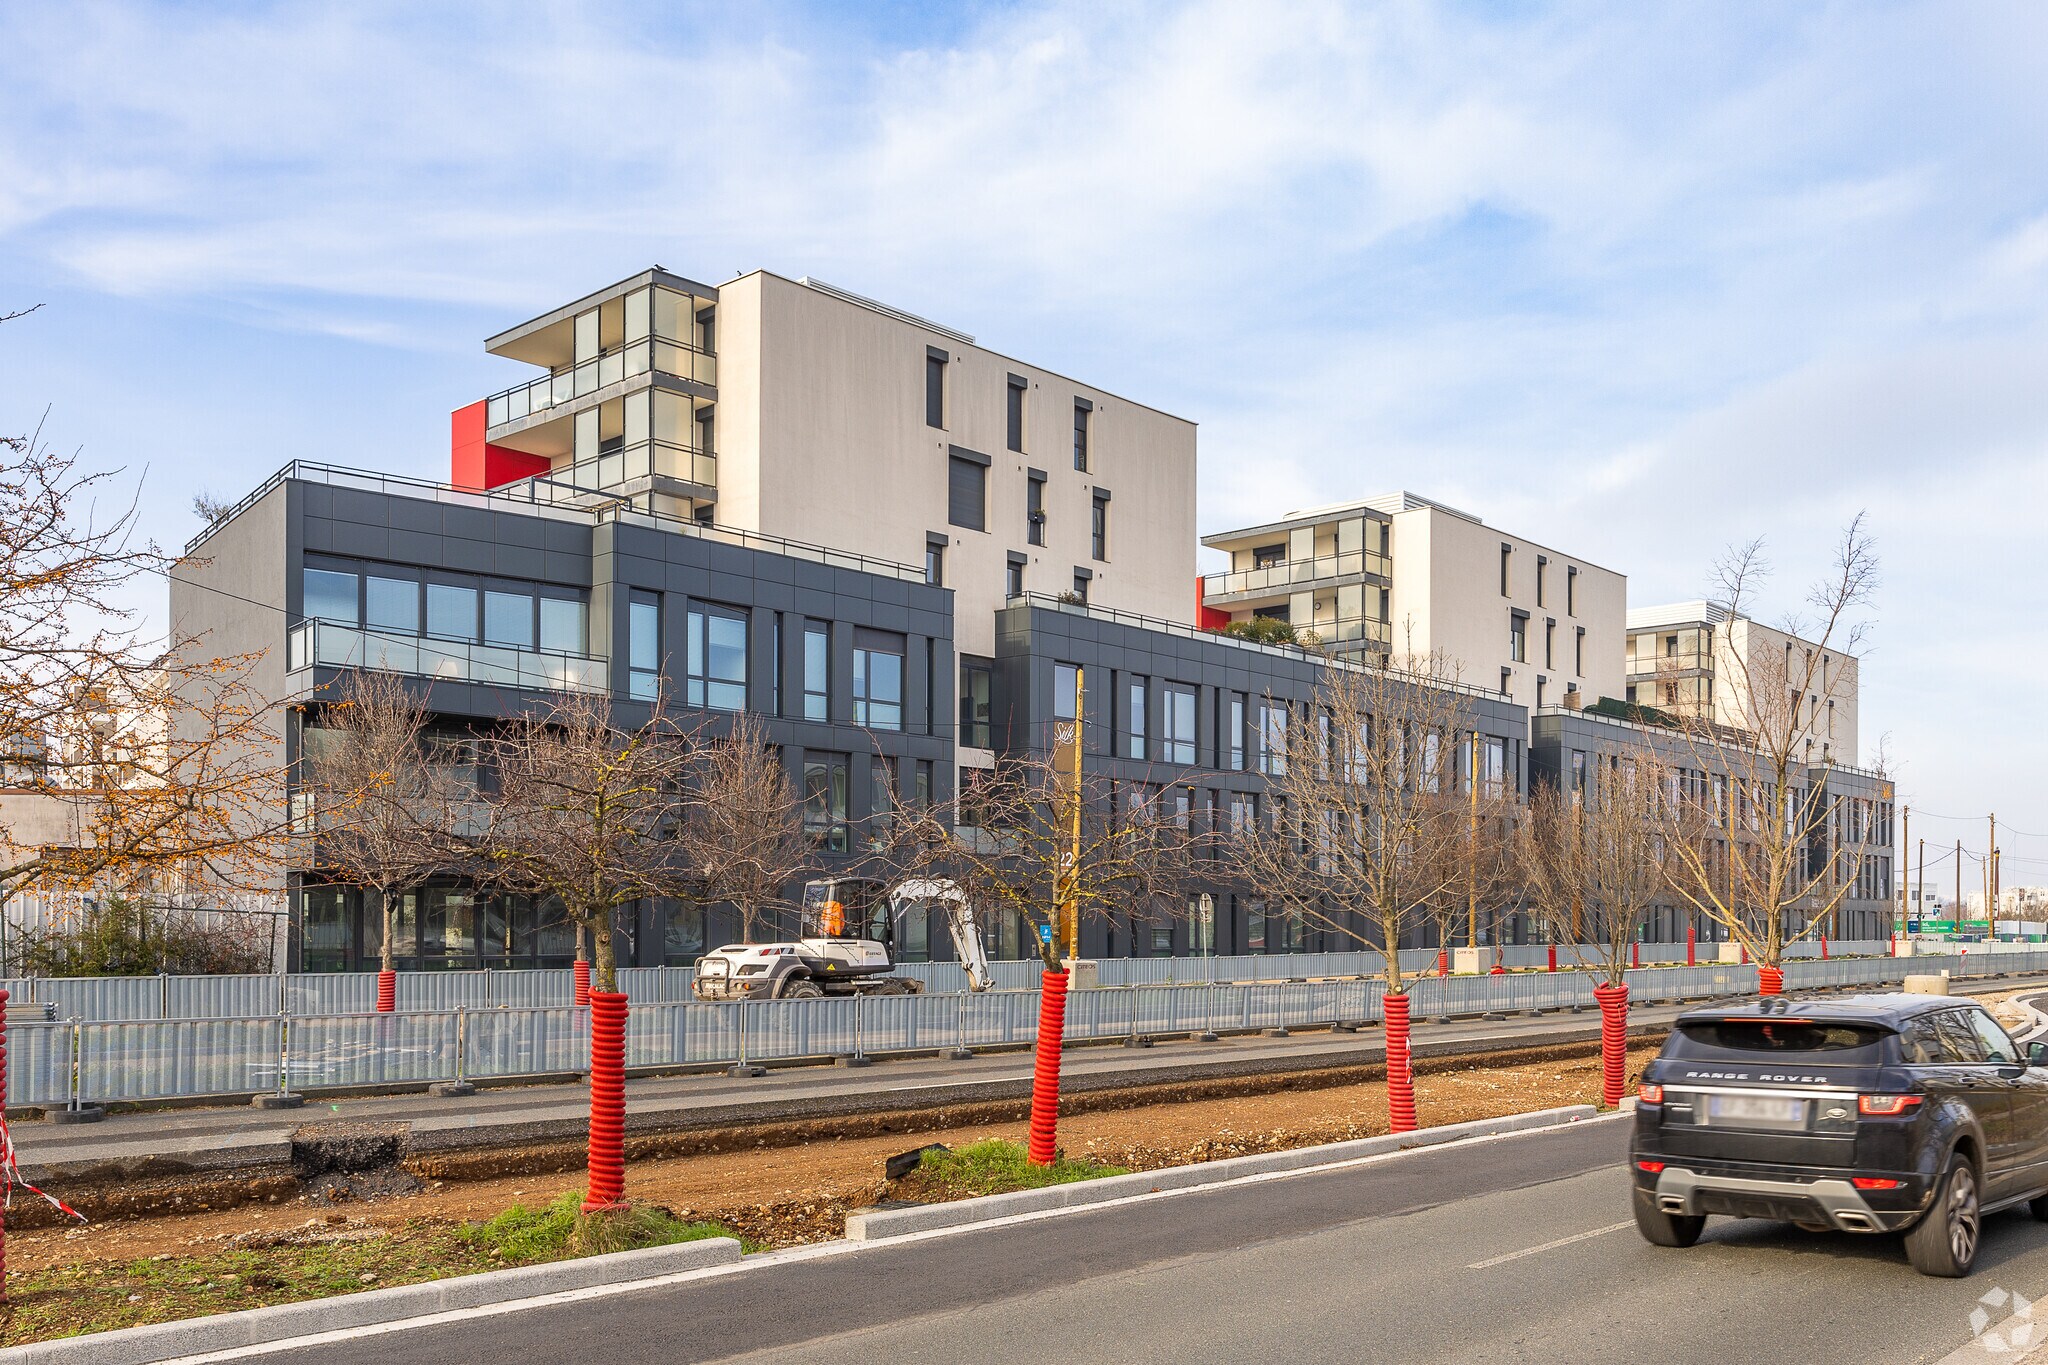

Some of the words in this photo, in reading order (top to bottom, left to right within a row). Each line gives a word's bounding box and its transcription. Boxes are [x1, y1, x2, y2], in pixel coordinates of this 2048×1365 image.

[1054, 722, 1075, 745] Silk
[1685, 1071, 1750, 1080] RANGE
[1759, 1074, 1828, 1083] ROVER
